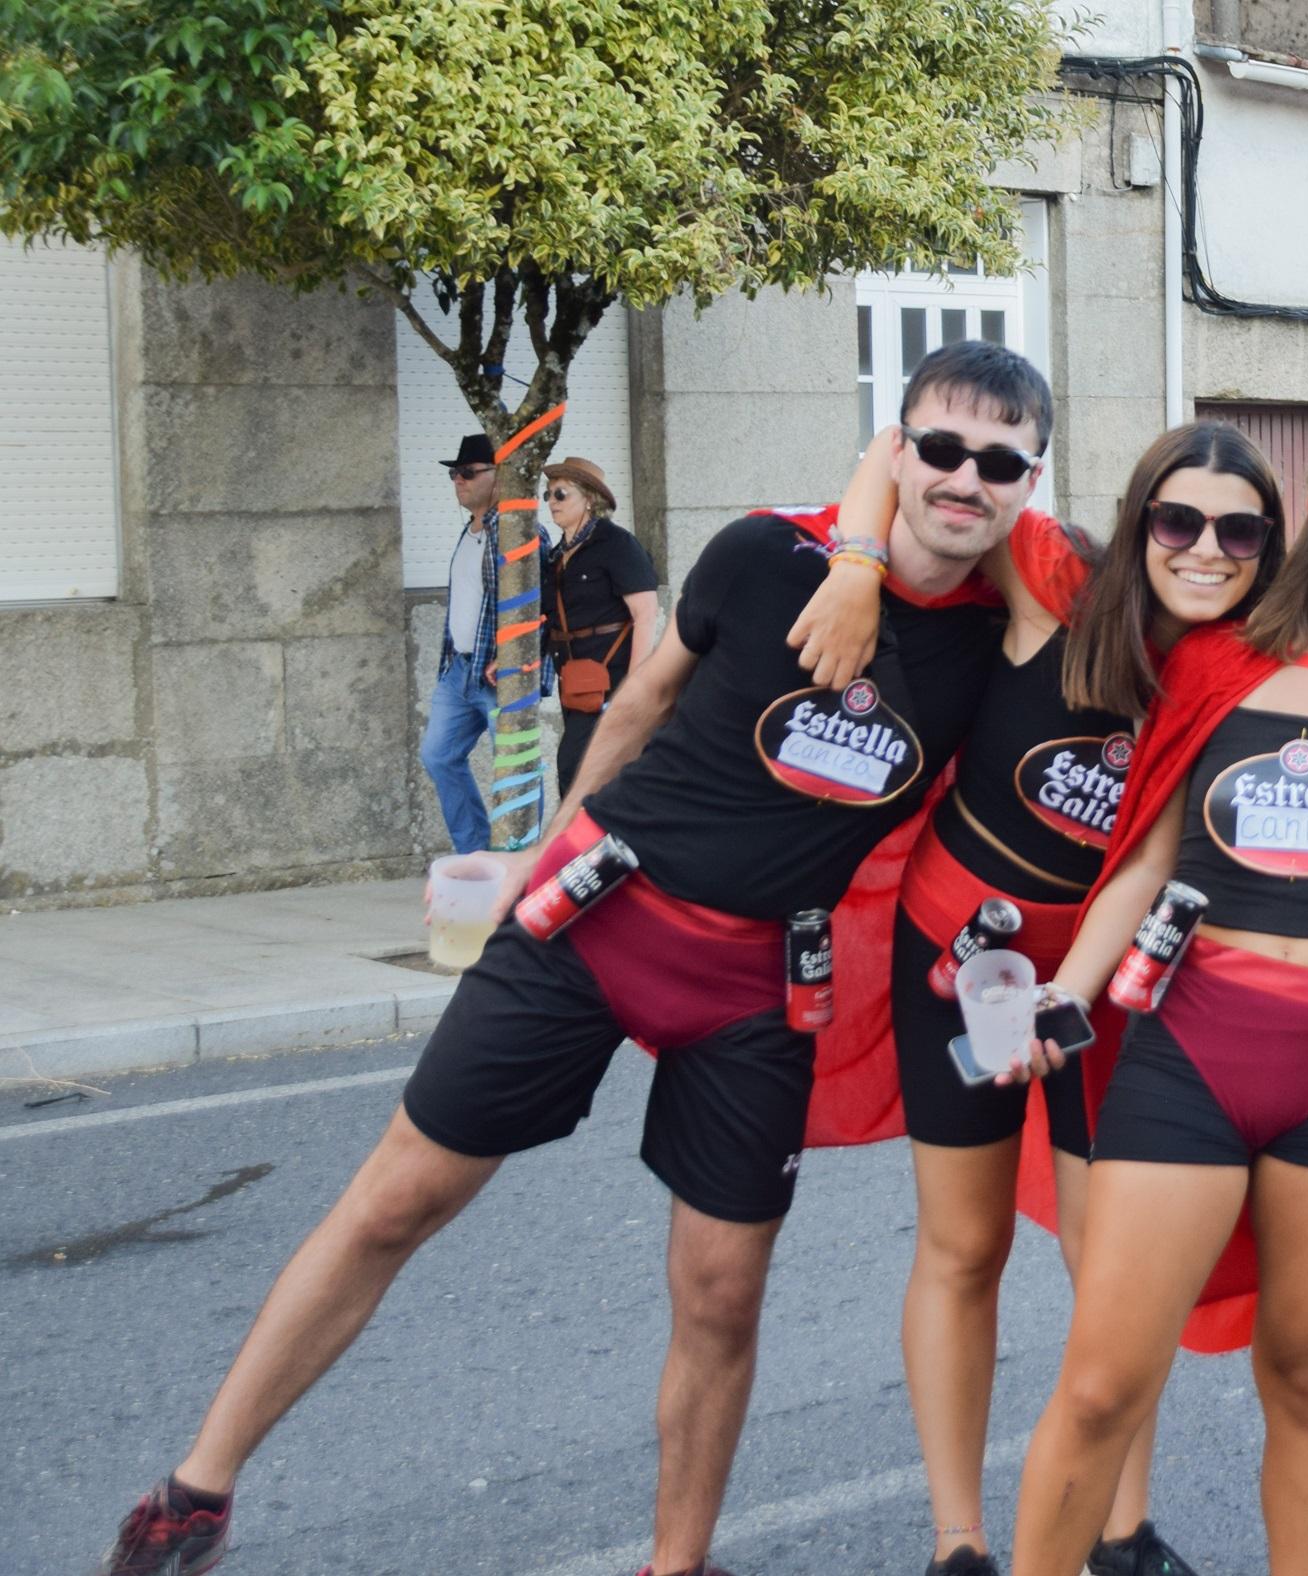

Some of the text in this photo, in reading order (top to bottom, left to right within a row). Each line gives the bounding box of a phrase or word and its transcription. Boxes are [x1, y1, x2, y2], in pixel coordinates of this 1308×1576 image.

[784, 700, 908, 766] Estrella
[1038, 780, 1118, 832] Galic
[1042, 750, 1126, 806] Estre
